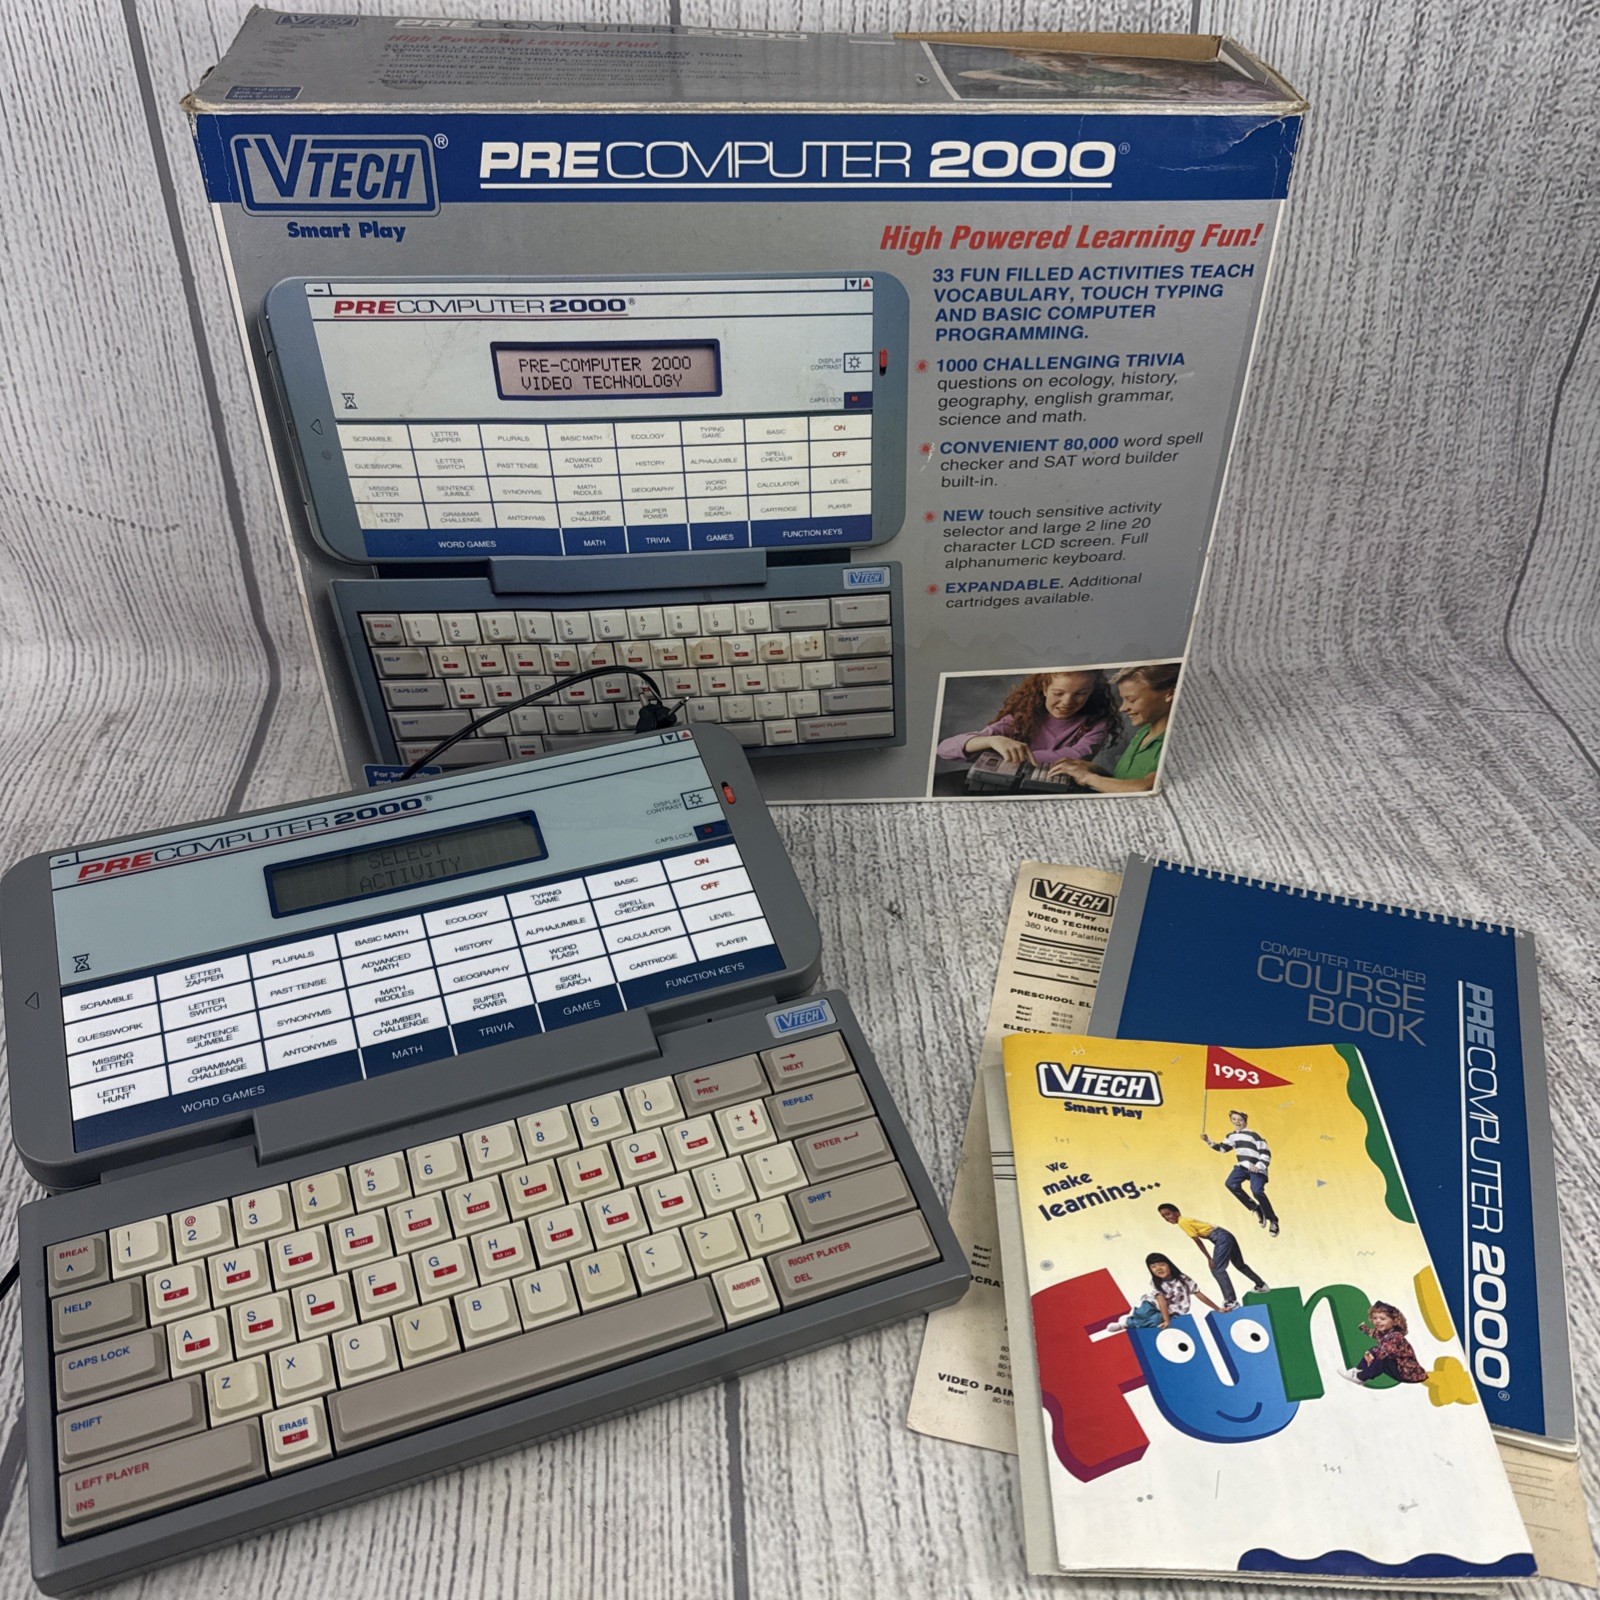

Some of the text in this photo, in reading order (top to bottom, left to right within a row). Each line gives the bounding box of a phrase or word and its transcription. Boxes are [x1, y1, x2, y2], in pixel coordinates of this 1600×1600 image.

[249, 134, 417, 199] VTECH
[480, 140, 1116, 179] PRECOMPUTER 2000
[288, 221, 406, 242] Smart Play
[880, 223, 1264, 255] High Powered Learning Fun!
[932, 263, 1254, 283] 33 FUN FILLED ACTIVITIES TEACH
[934, 283, 1224, 304] VOCABULARY, TOUCH TYPING
[333, 298, 627, 315] PRECOMPUTER 2000
[935, 304, 1156, 323] AND BASIC COMPUTER
[935, 326, 1088, 342] PROGRAMMING.
[519, 355, 692, 373] PRE-COMPUTER 2000
[936, 352, 1185, 373] 1000 CHALLENGING TRIVIA
[521, 374, 683, 390] VIDEO TECHNOLOGY
[937, 370, 1178, 390] questions on ecology, history,
[938, 389, 1174, 411] geography, english grammar,
[939, 409, 1087, 426] science and math.
[834, 424, 846, 432] ON
[940, 432, 1203, 455] CONVENIENT 80,000 word spell
[940, 451, 1179, 471] checker and SAT word builder
[941, 475, 998, 488] built-in.
[943, 501, 1162, 522] NEW touch sensitive activity
[782, 527, 843, 538] FUNCTION KEYS
[943, 517, 1151, 538] selector and large 2 line 20
[438, 539, 497, 549] WORD GAMES
[584, 538, 606, 547] MATH
[645, 536, 671, 545] TRIVIA
[706, 533, 734, 542] GAMES
[944, 533, 1148, 553] character LCD screen. Full
[944, 550, 1126, 570] alphanumeric keyboard.
[849, 570, 882, 584] VTECH
[945, 573, 1142, 594] EXPANDABLE. Additional
[945, 591, 1094, 610] cartridges available.
[77, 798, 423, 881] PRECOMPUTER 2000
[368, 841, 444, 870] SELECT
[694, 857, 710, 866] ON
[360, 855, 461, 893] ACTIVITY
[613, 876, 639, 887] BASIC
[701, 881, 720, 892] OFF
[1043, 880, 1107, 912] VTECH
[445, 911, 488, 926] ECOLOGY
[525, 917, 586, 936] ALPHAJUMBLE
[1027, 910, 1059, 924] VIDEO
[354, 929, 409, 947] BASIC MATH
[616, 926, 672, 944] CALCULATOR
[1025, 921, 1108, 943] 380 West Palatine
[716, 936, 748, 948] PLAYER
[271, 951, 315, 966] PLURALS
[629, 953, 678, 971] CARTRIDGE
[1260, 940, 1426, 984] COMPUTER TEACHER
[453, 965, 510, 984] GEOGRAPHY
[665, 962, 745, 989] FUNCTION KEYS
[1256, 954, 1426, 1015] COURSE
[80, 993, 134, 1011] SCRAMBLE
[1010, 987, 1076, 1006] PRESCHOOL
[563, 1000, 601, 1015] GAMES
[276, 1008, 332, 1027] SYNONYMS
[779, 1007, 821, 1030] VTECH
[1308, 994, 1427, 1047] BOOK
[77, 1022, 143, 1044] GUESSWORK
[478, 1022, 515, 1037] TRIVIA
[282, 1039, 337, 1058] ANTONYMS
[391, 1045, 424, 1060] MATH
[1049, 1063, 1147, 1099] VTECH
[1213, 1062, 1260, 1085] 1993
[181, 1085, 266, 1114] WORD GAMES
[782, 1094, 814, 1107] REPEAT
[1063, 1101, 1143, 1120] Smart Play
[813, 1136, 842, 1150] ENTER
[1042, 1171, 1093, 1196] make
[1465, 981, 1511, 1388] PRECOMPUTER 2000
[808, 1191, 832, 1204] SHIFT
[1038, 1180, 1161, 1222] learning...
[787, 1242, 851, 1268] RIGHT PLAYER
[732, 1277, 761, 1292] ANSWER
[64, 1301, 92, 1314] HELP
[68, 1346, 131, 1371] CAPS LOCK
[938, 1372, 979, 1389] VIDEO
[70, 1416, 102, 1432] SHIFT
[278, 1417, 309, 1432] ERASE
[75, 1462, 150, 1491] LEFT PLAYER
